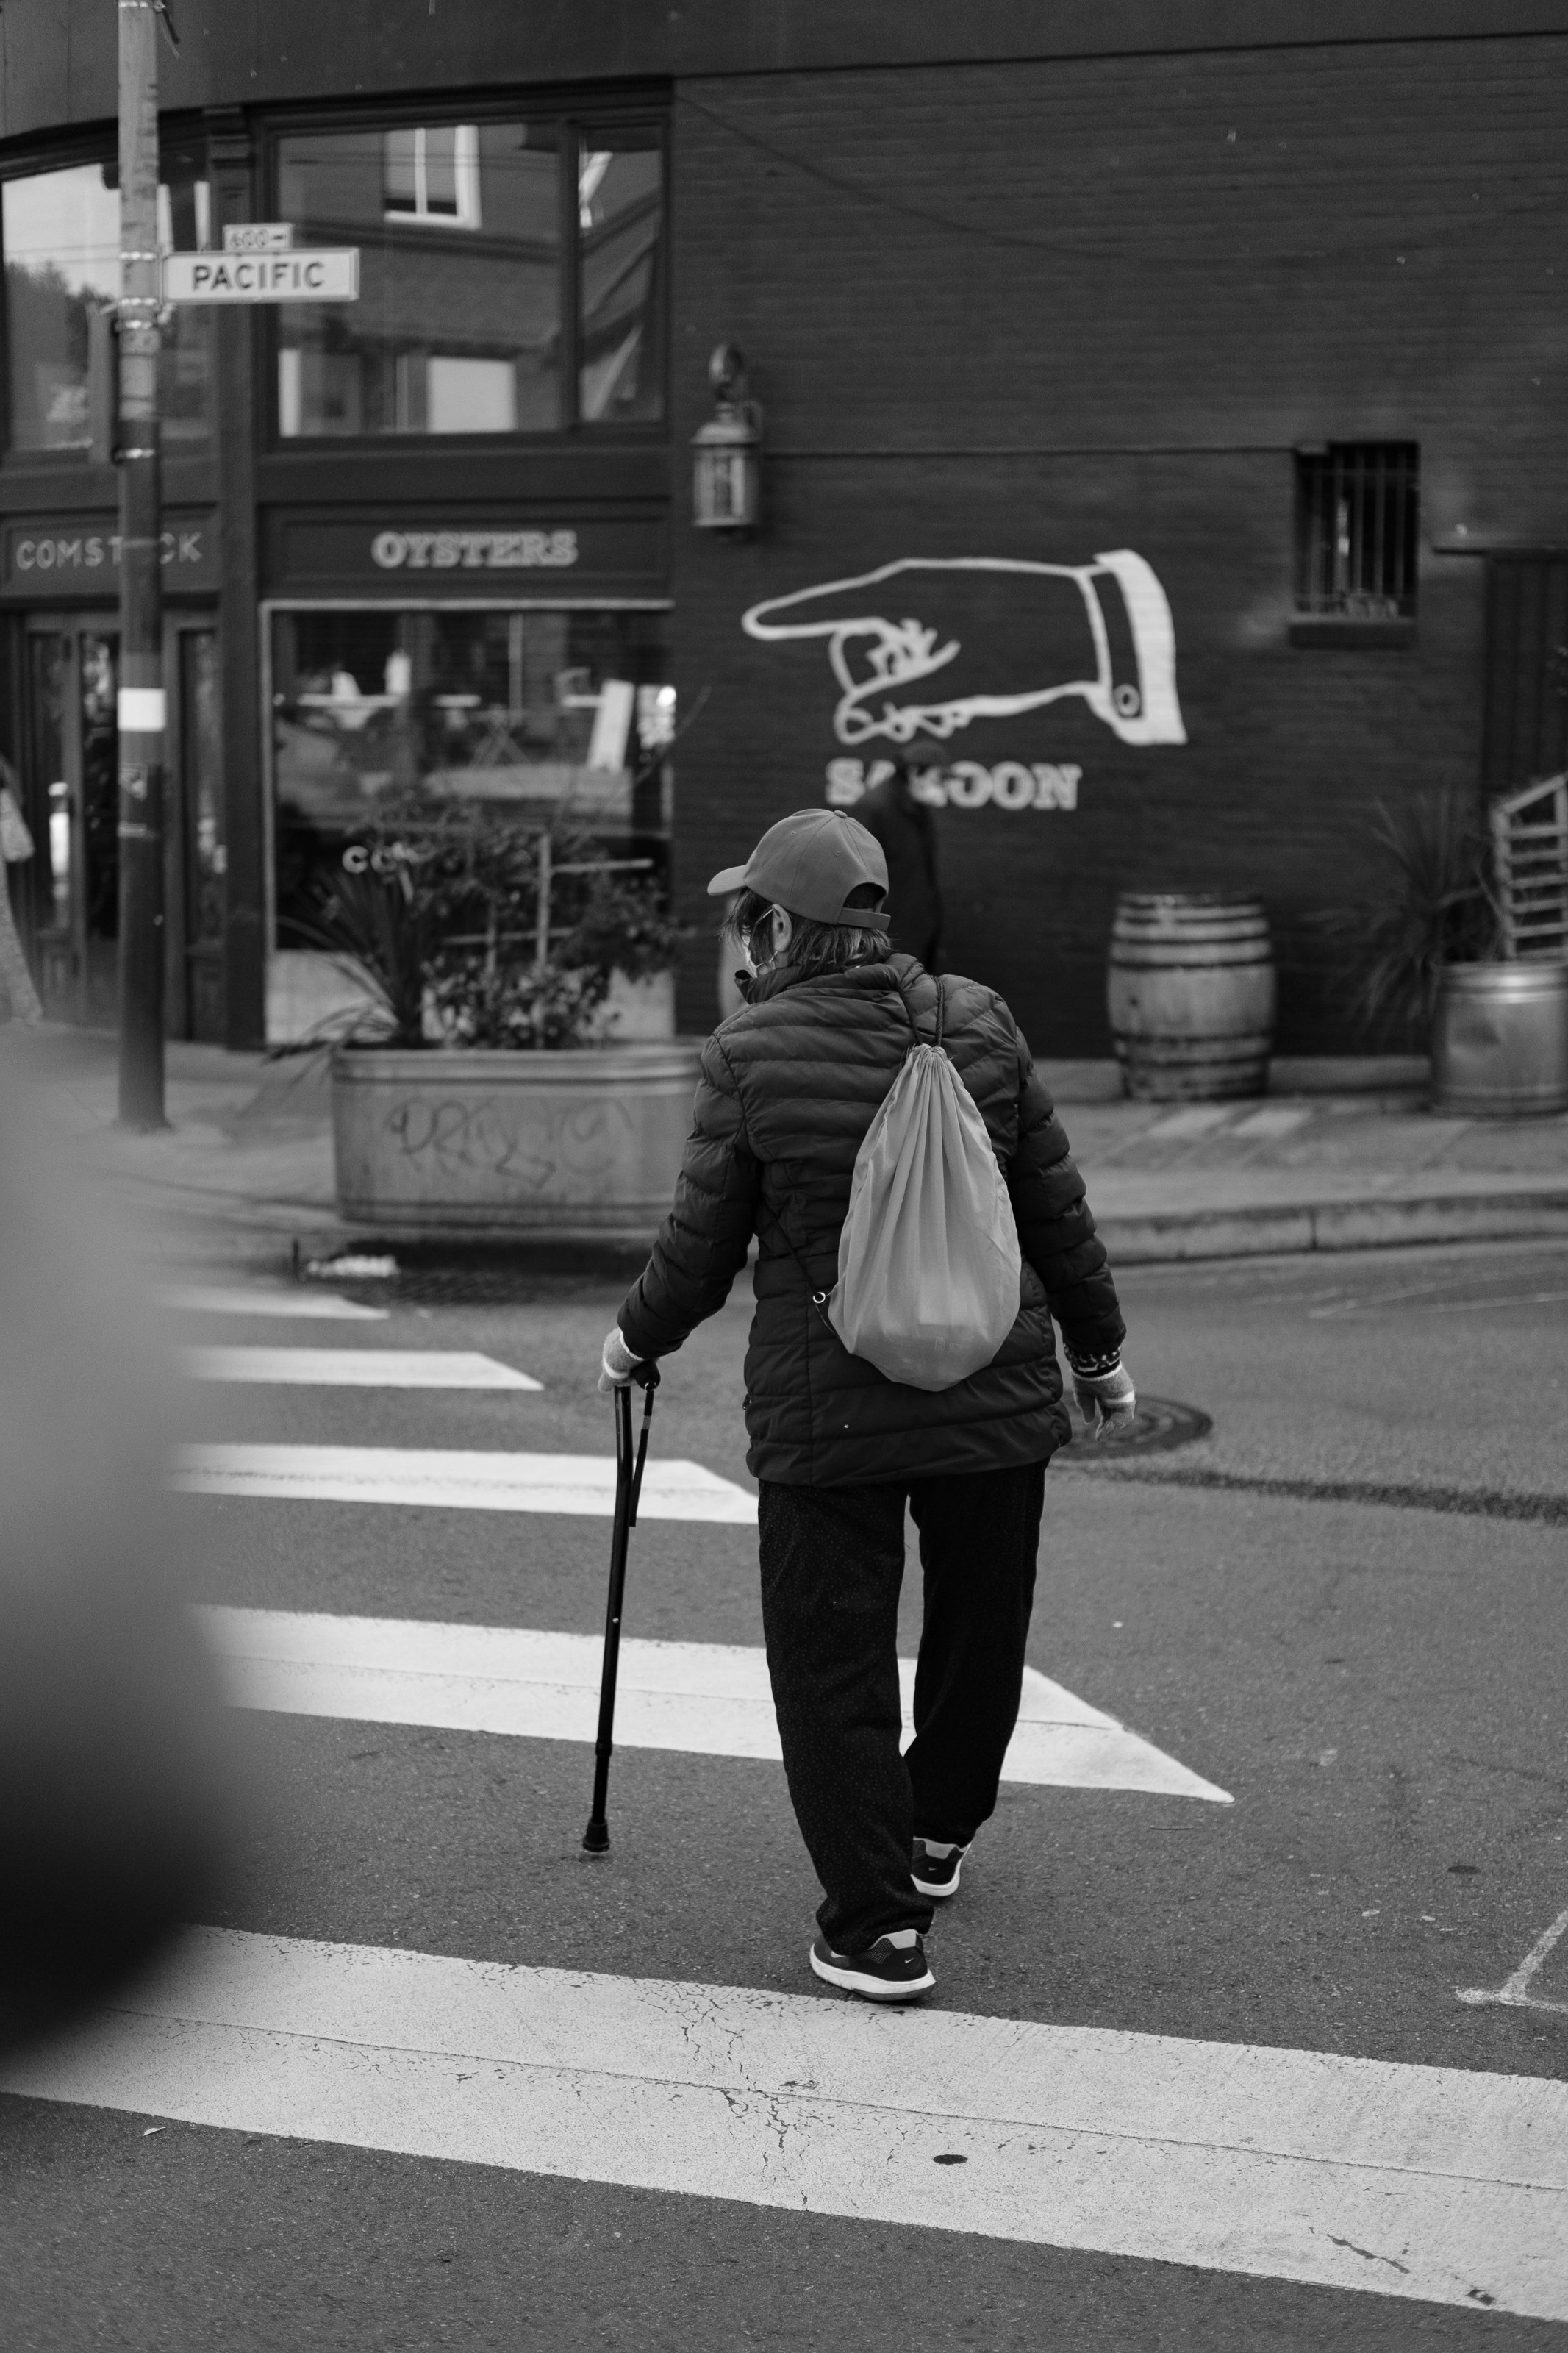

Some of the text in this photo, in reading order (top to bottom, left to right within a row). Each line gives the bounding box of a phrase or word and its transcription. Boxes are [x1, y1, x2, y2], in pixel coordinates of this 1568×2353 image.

[192, 261, 325, 292] PACIFIC
[16, 532, 203, 571] COMSTCK
[370, 529, 579, 569] OYSTERS
